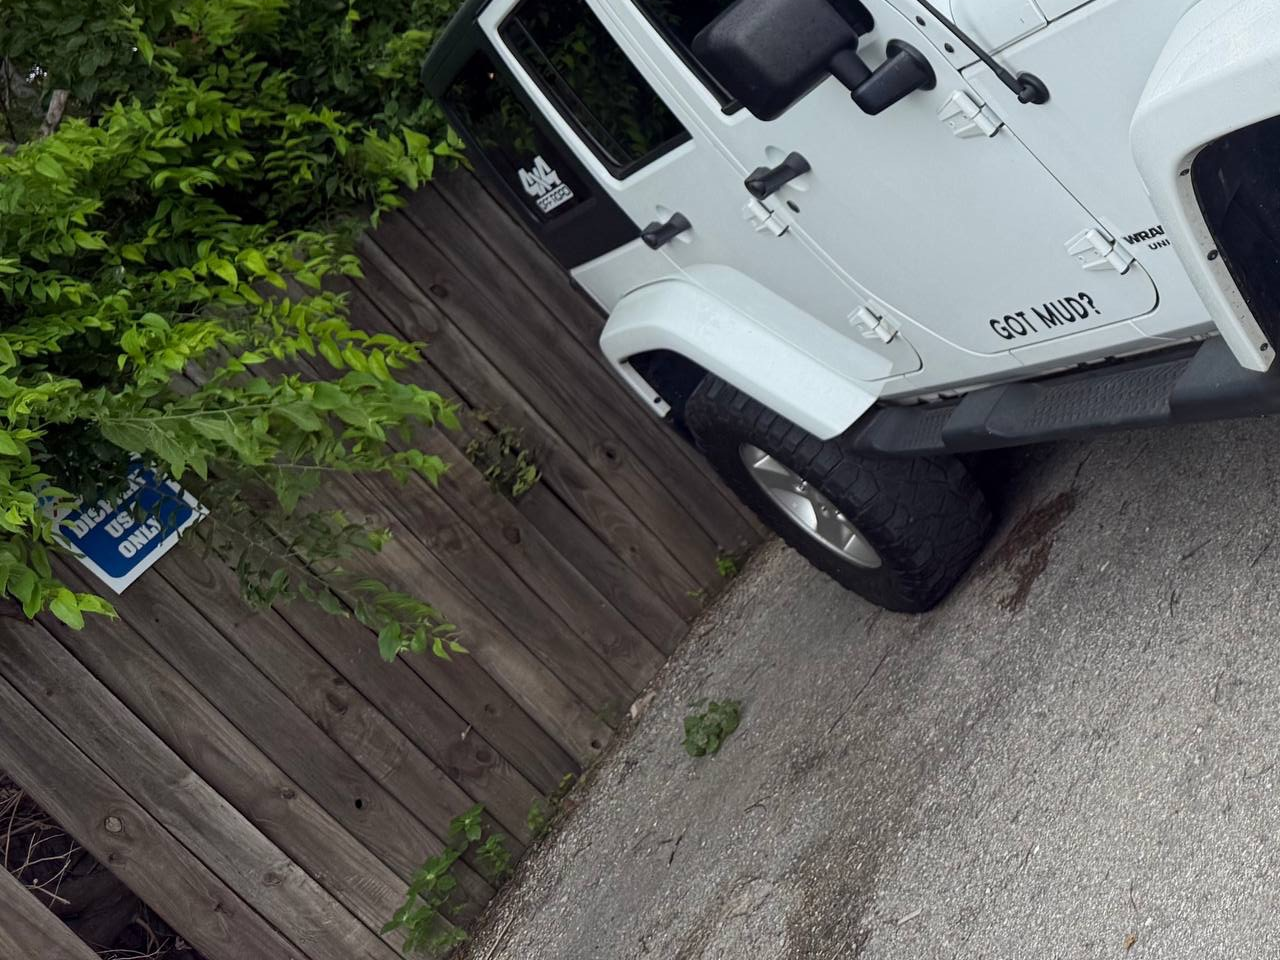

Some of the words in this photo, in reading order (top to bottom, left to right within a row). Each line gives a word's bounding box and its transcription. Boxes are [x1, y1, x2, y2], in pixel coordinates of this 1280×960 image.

[989, 313, 1039, 340] GOT
[1030, 292, 1102, 329] MUD?
[117, 515, 163, 559] ONLY
